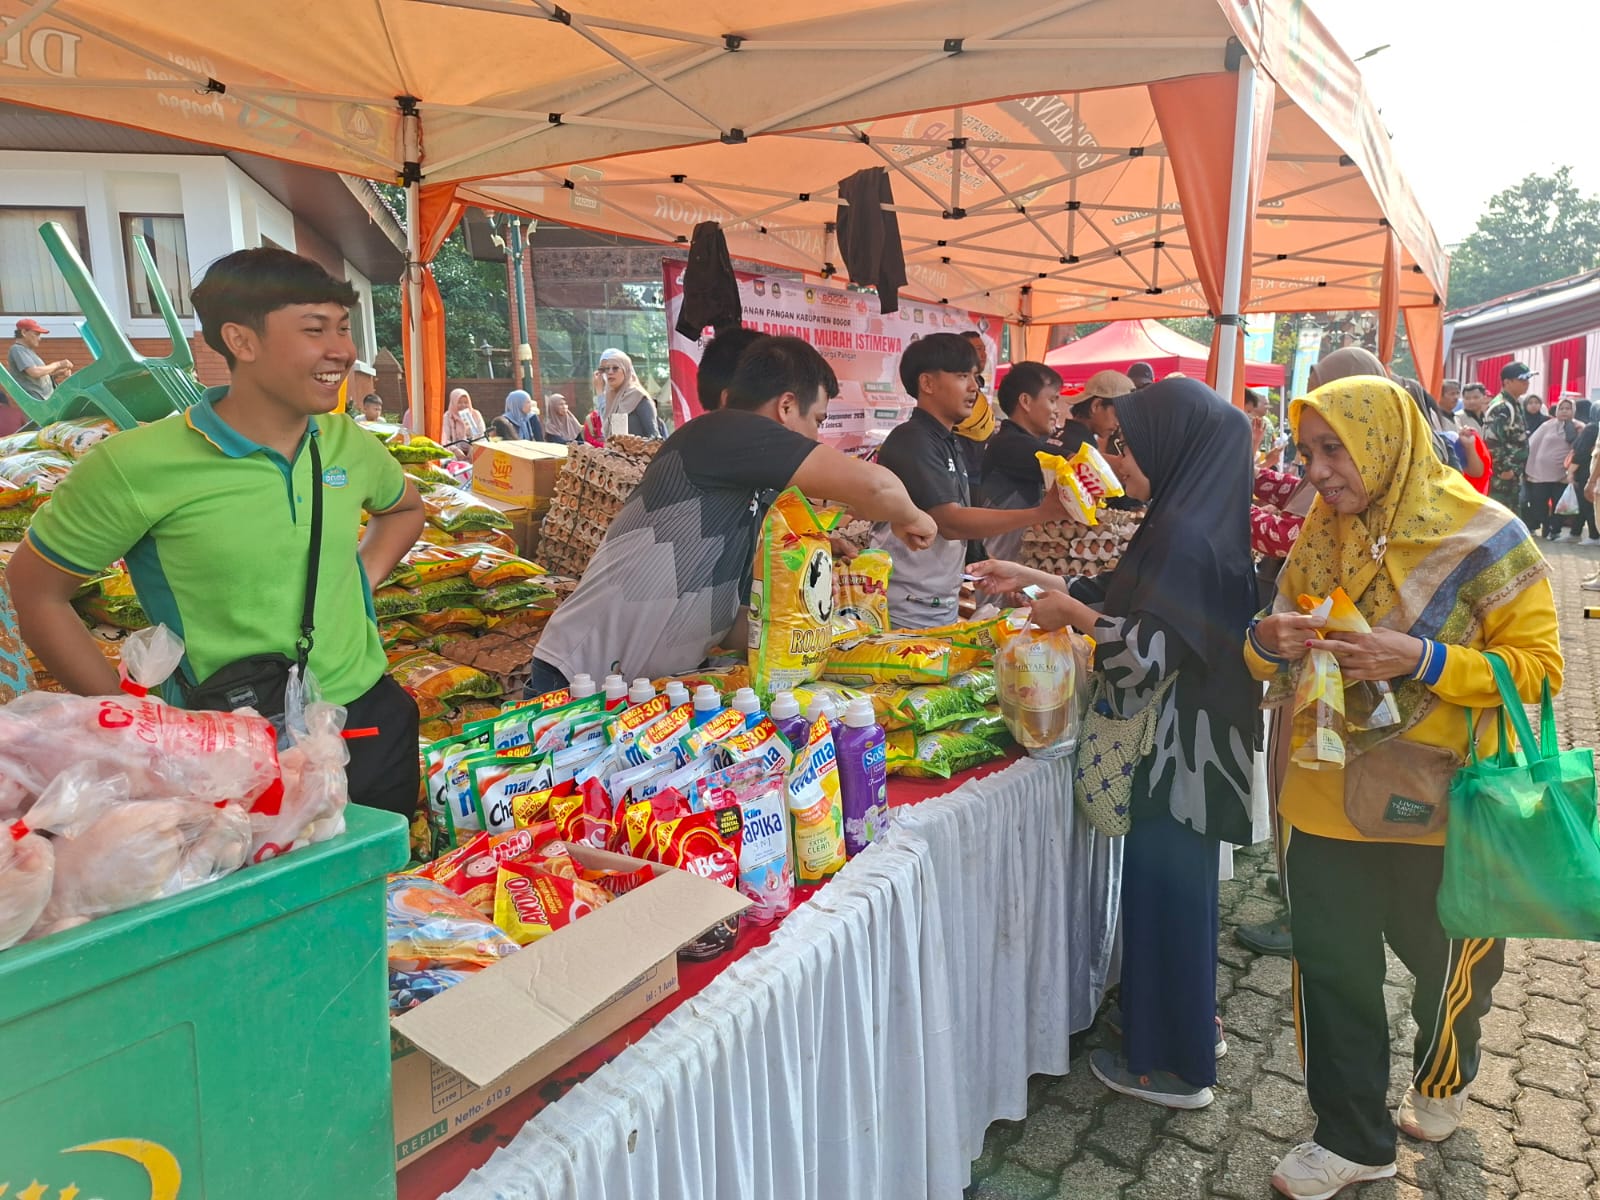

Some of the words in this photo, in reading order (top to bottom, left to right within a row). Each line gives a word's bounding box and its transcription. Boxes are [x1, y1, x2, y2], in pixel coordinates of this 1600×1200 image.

[766, 308, 795, 320] PANGAN
[796, 312, 832, 326] KABUPATEN
[833, 318, 851, 327] BOGOR
[814, 329, 853, 349] MURAH
[855, 334, 902, 353] ISTIMEWA
[837, 351, 857, 362] Pangan
[807, 841, 830, 855] CLEAN
[686, 851, 727, 879] ABC
[711, 871, 734, 885] ANIS
[504, 876, 549, 926] AKUMO
[454, 1102, 485, 1126] Netto:
[486, 1088, 503, 1107] 610
[504, 1085, 512, 1097] g
[401, 1123, 446, 1156] REFILL
